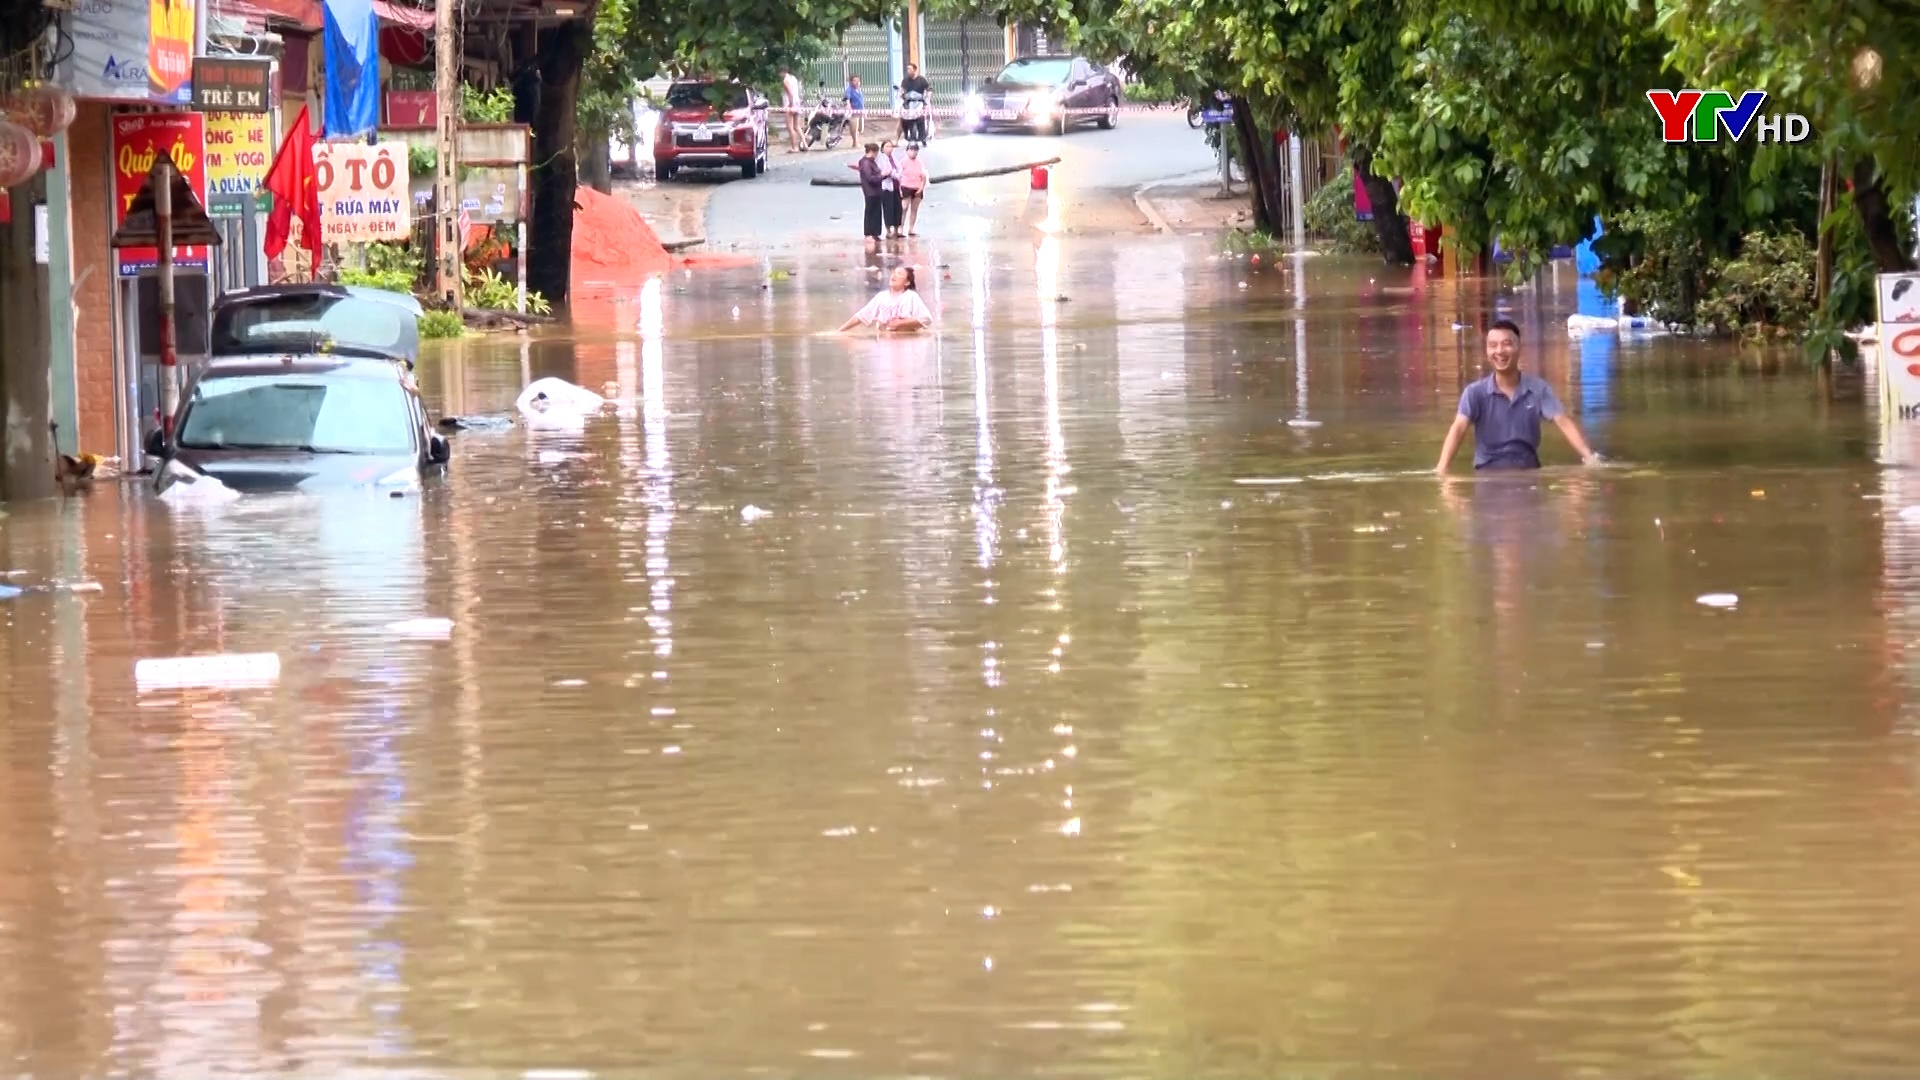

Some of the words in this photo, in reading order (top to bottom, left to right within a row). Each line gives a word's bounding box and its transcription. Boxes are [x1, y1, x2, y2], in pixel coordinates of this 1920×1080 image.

[103, 55, 148, 79] ALRA
[201, 84, 233, 106] TRẺ
[237, 90, 260, 106] EM
[205, 128, 233, 144] ÔNG
[119, 138, 158, 178] Quầ
[234, 152, 265, 166] YOGA
[345, 149, 395, 190] TÔ
[335, 195, 364, 216] RỬA
[369, 198, 400, 215] MÁY
